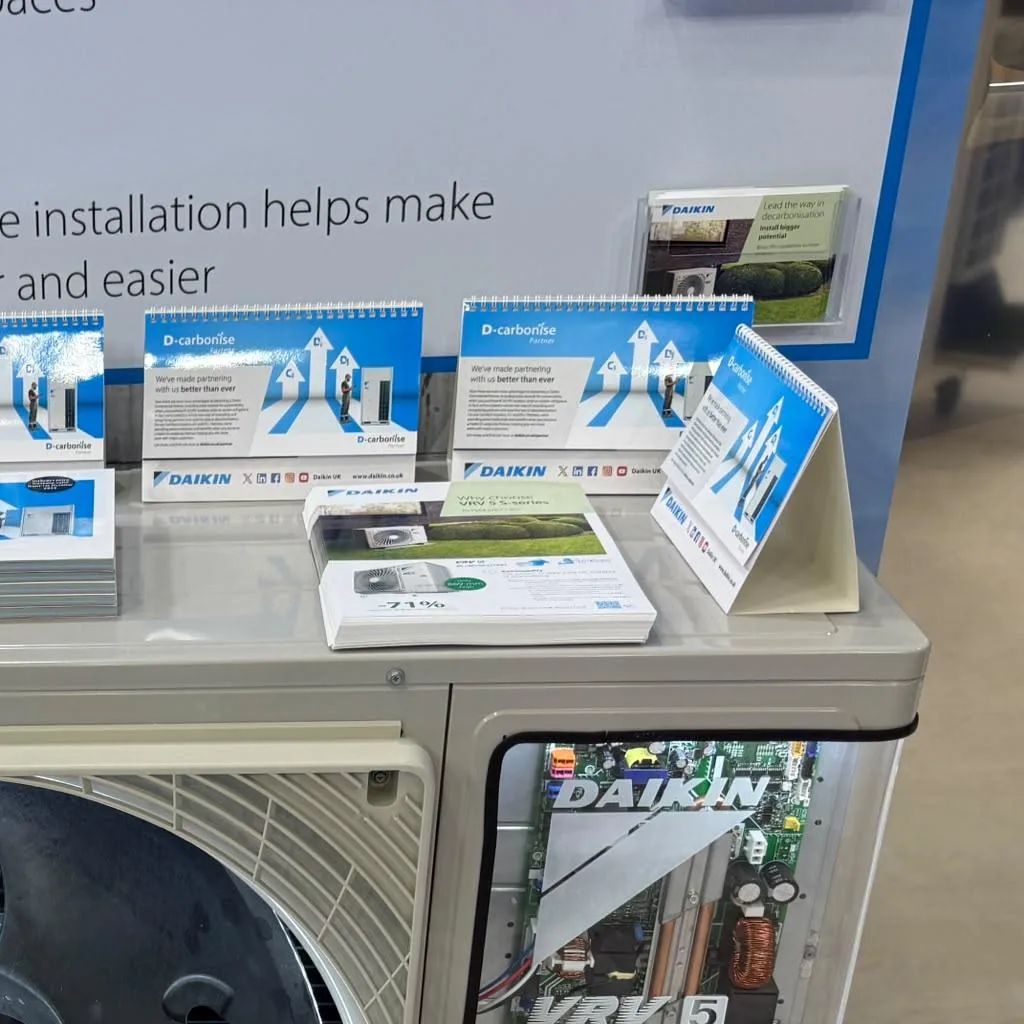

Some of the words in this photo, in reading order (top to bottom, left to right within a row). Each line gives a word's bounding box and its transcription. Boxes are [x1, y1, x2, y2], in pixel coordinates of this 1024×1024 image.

[34, 193, 248, 238] installation
[263, 186, 369, 236] helps
[385, 181, 495, 224] make
[672, 204, 715, 215] DAIKIN
[763, 201, 783, 210] Lead
[784, 201, 799, 209] the
[799, 201, 816, 209] way
[758, 233, 787, 241] potential
[17, 260, 88, 301] and
[102, 259, 216, 298] easier
[481, 322, 556, 336] D-carbonise
[163, 332, 236, 346] D-carbonise
[493, 365, 513, 373] made
[514, 365, 552, 375] partnering
[176, 375, 195, 383] made
[196, 375, 232, 384] partnering
[496, 375, 519, 383] better
[520, 375, 537, 383] than
[180, 385, 202, 393] better
[203, 385, 219, 393] than
[479, 465, 548, 477] DAIKIN
[169, 473, 232, 485] DAIKIN
[346, 487, 419, 496] DAIKIN
[666, 496, 688, 526] DAIKIN
[552, 777, 771, 810] DAIKIN
